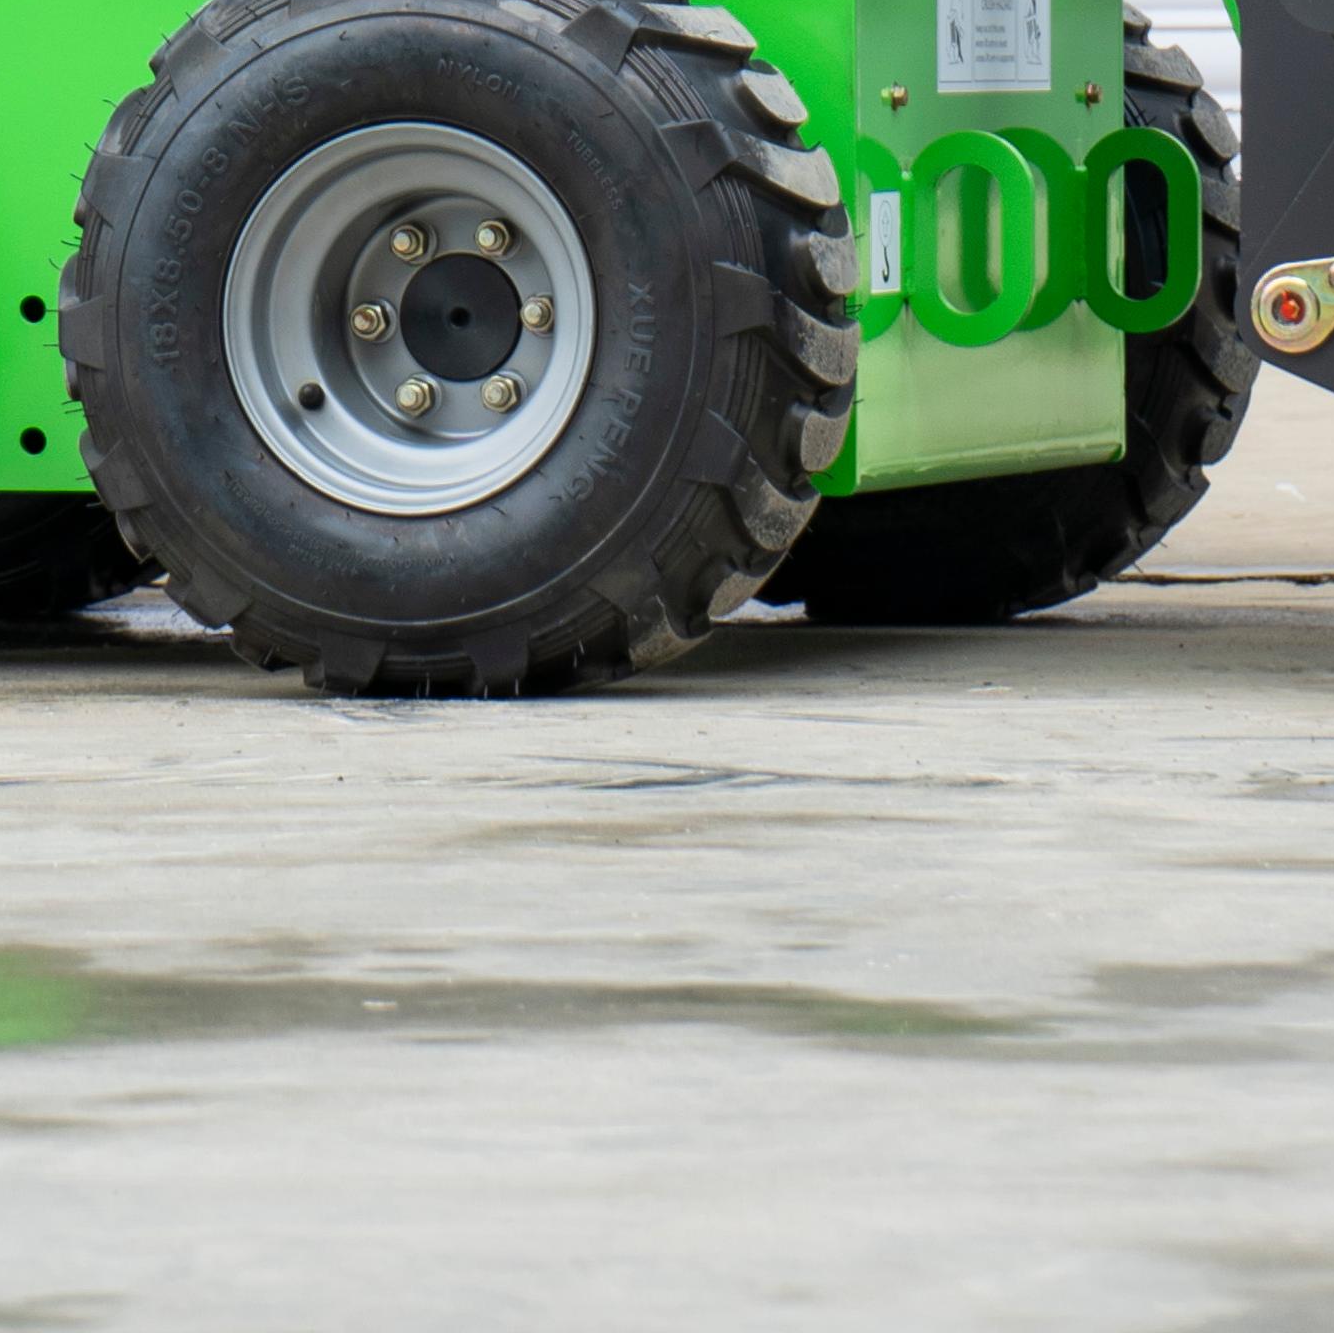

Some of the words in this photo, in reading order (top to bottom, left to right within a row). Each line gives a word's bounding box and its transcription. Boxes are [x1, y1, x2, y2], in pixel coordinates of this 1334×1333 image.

[436, 57, 522, 101] NYLON
[566, 129, 627, 212] TUBELESS
[149, 146, 230, 366] 18X8.50-8
[625, 281, 657, 374] XUE
